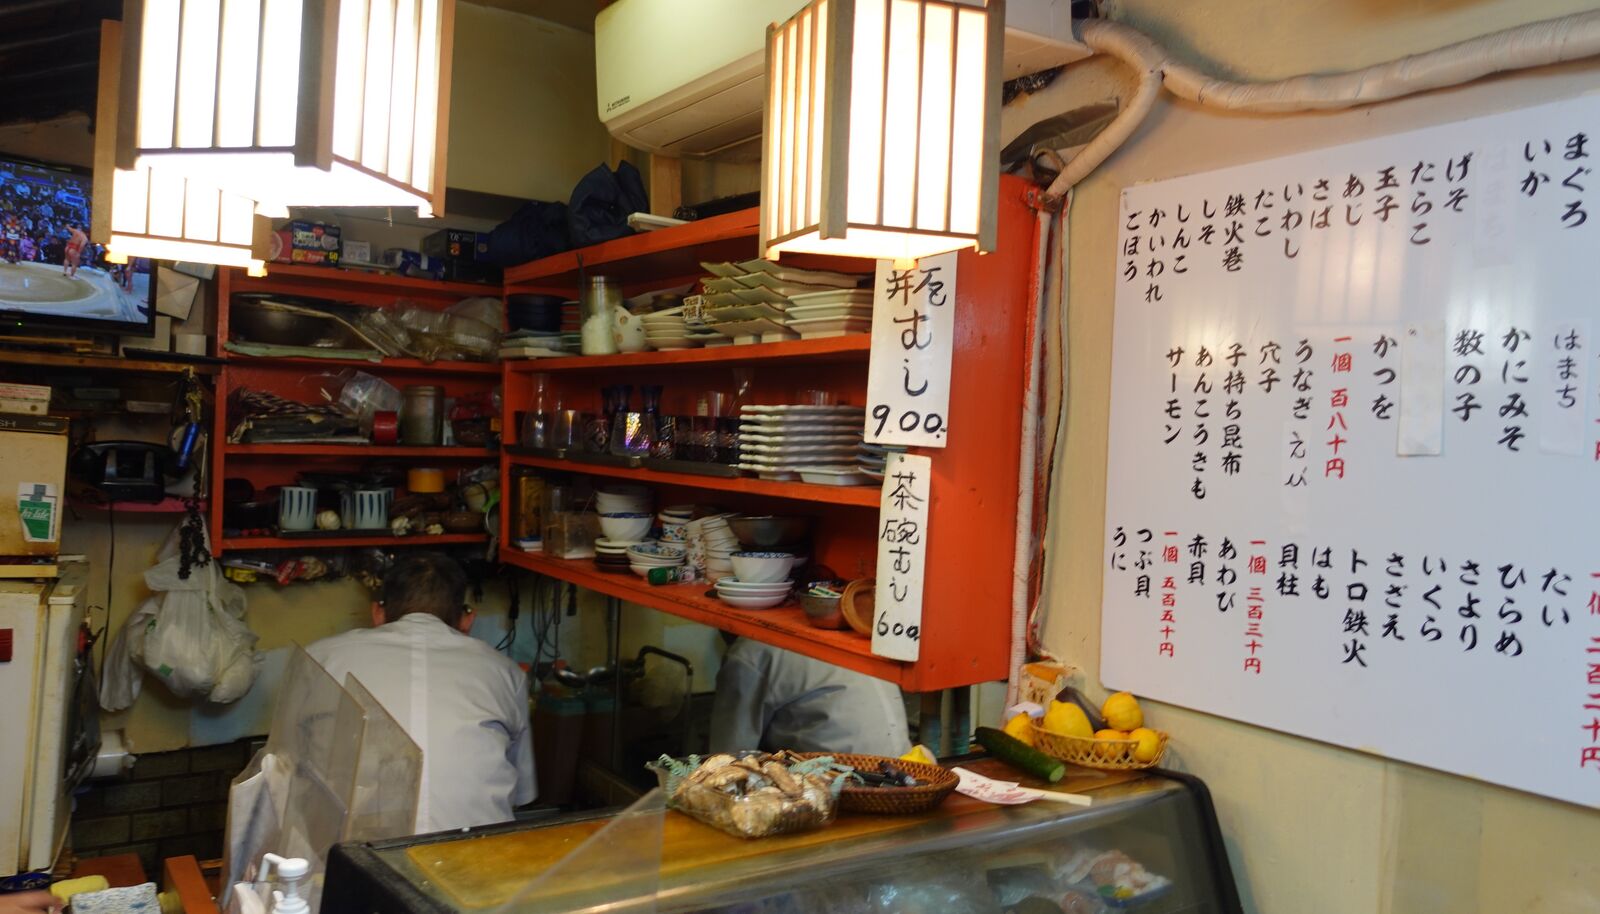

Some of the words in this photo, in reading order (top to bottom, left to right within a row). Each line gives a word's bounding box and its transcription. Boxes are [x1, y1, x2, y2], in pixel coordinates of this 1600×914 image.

[1310, 178, 1335, 230] さば
[1342, 173, 1366, 227] あじ
[1372, 165, 1401, 223] 玉子
[1409, 160, 1436, 246] たらこ
[1443, 151, 1474, 213] げそ
[1520, 139, 1552, 198] いか
[1560, 131, 1593, 229] まぐろ
[1123, 210, 1143, 282] ごぼう
[1171, 203, 1192, 275] しんこ
[1197, 199, 1217, 246] しそ
[1222, 193, 1247, 273] 鉄火巻
[1254, 188, 1274, 238] たこ
[1279, 183, 1304, 259] いわし
[1144, 207, 1167, 304] かいわれ
[1257, 340, 1282, 394] 穴子
[1292, 338, 1314, 420] うなぎ
[1330, 335, 1353, 374] 一個
[1371, 334, 1398, 421] かつを
[1451, 329, 1485, 423] 数の子
[1497, 326, 1532, 453] かにみそ
[1554, 328, 1582, 409] はまち
[1163, 346, 1186, 445] サーモン
[1190, 345, 1214, 501] あんこうきも
[1220, 342, 1248, 477] 子持ち昆布
[1324, 387, 1349, 480] 百八十円
[1284, 431, 1308, 488] えび
[881, 471, 925, 602] 茶碗むし
[1111, 526, 1127, 572] うに
[1133, 528, 1153, 599] つぶ貝
[1161, 531, 1179, 564] 一個
[1186, 533, 1209, 587] 赤貝
[1247, 539, 1267, 576] 一個
[1275, 542, 1301, 598] 貝柱
[1311, 546, 1334, 601] はも
[1159, 576, 1177, 658] 五百五十円
[1243, 587, 1265, 675] 三百三十円
[1341, 548, 1370, 668] トロ鉄火
[1381, 552, 1408, 642] さざえ
[1419, 555, 1447, 642] いくら
[1457, 559, 1482, 652] さより
[1493, 563, 1527, 658] ひらめ
[1541, 567, 1573, 628] たい
